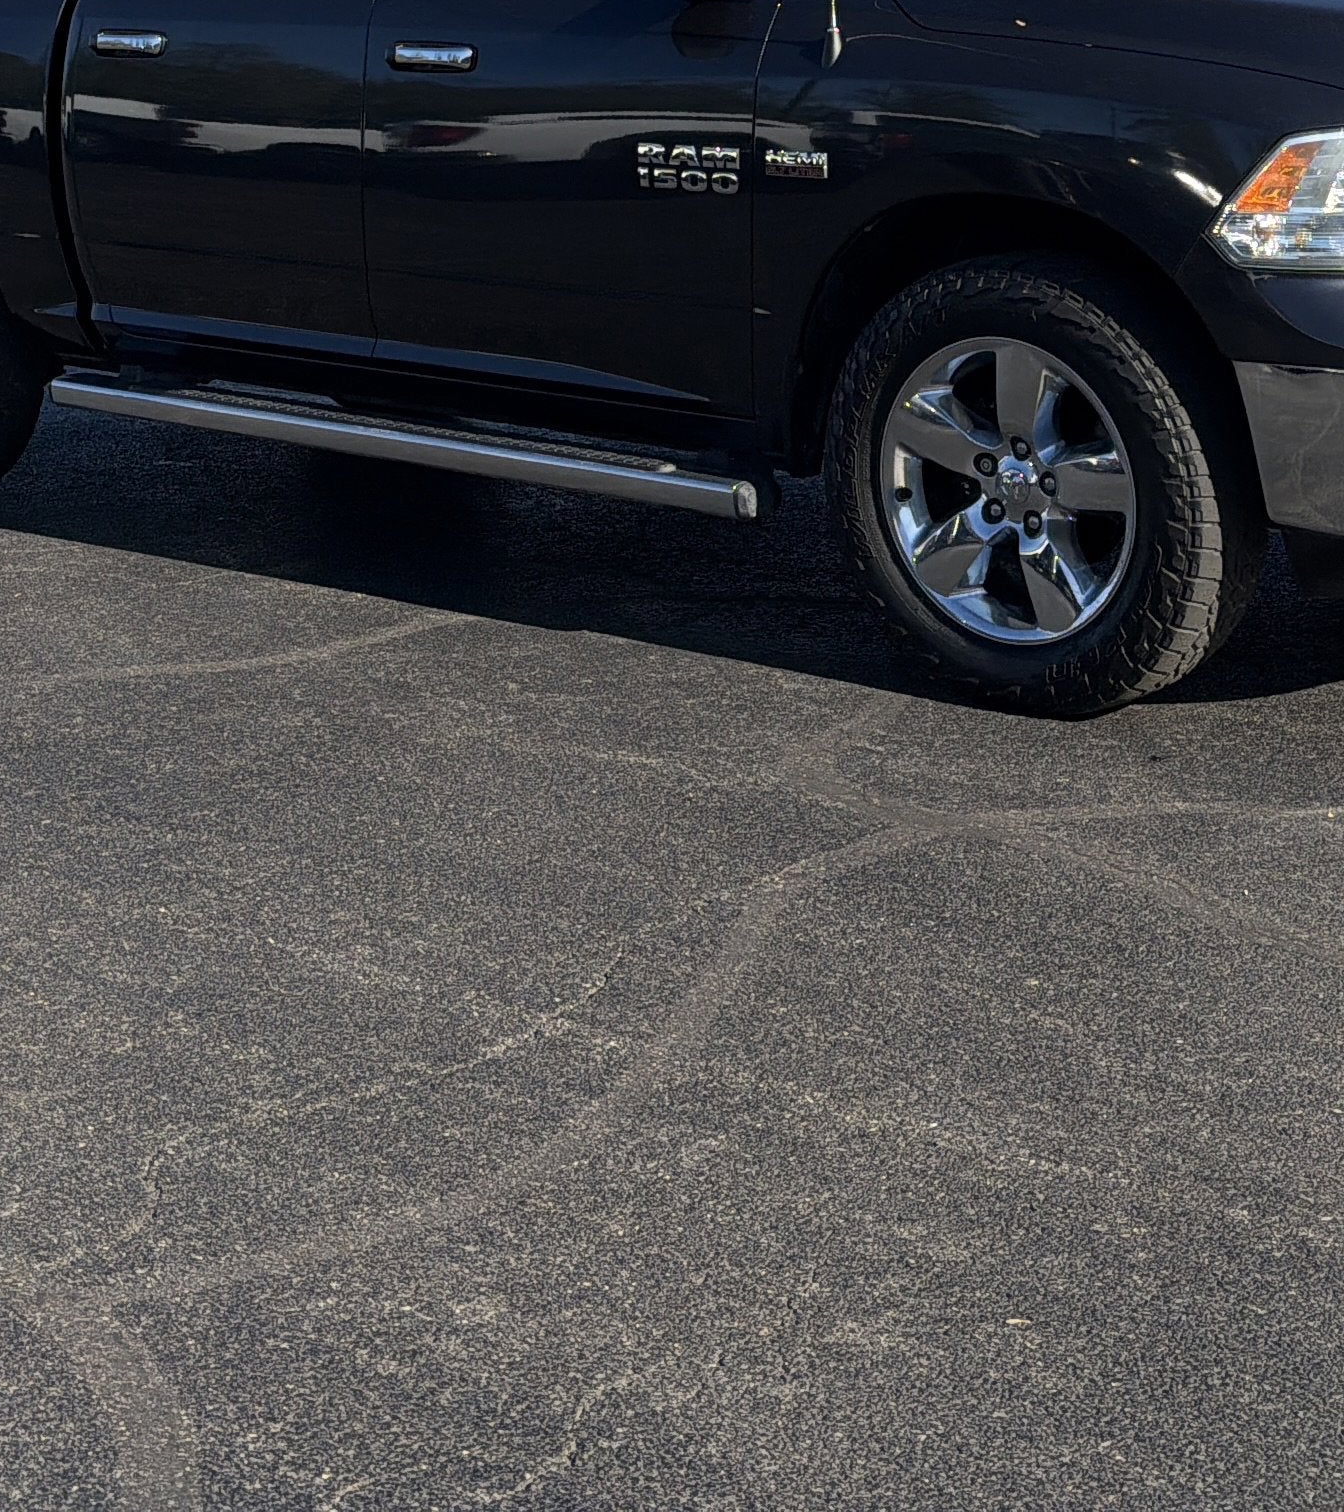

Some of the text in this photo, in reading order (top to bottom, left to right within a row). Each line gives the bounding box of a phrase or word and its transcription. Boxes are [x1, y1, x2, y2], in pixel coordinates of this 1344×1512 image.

[637, 142, 740, 170] RAM
[765, 150, 827, 166] HEMI
[637, 166, 739, 195] 1500
